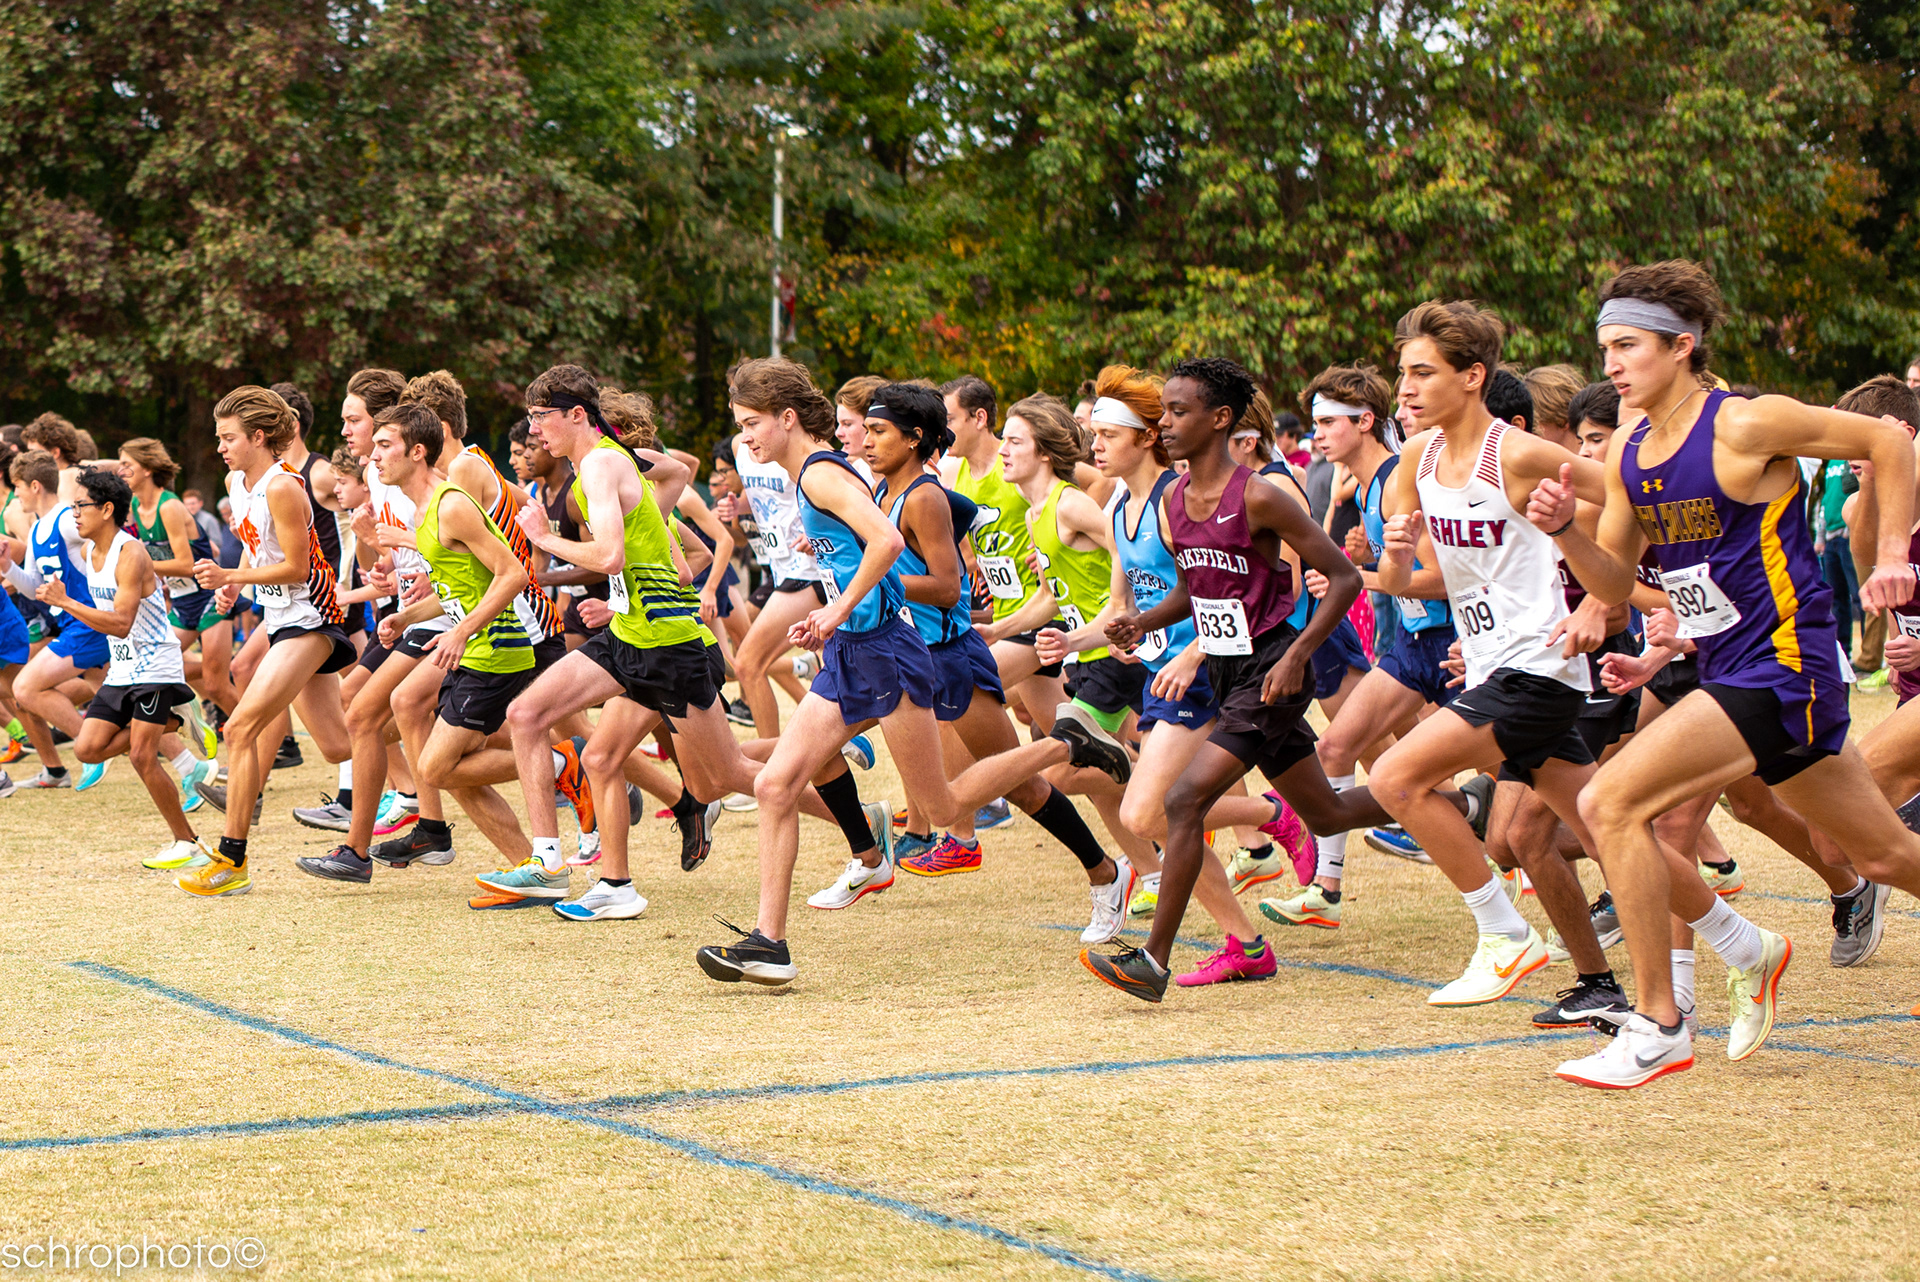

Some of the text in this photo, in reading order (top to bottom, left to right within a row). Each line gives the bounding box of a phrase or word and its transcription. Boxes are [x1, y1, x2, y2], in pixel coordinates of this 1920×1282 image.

[1668, 583, 1717, 618] 392
[1200, 612, 1238, 639] 633
[112, 644, 133, 662] 382
